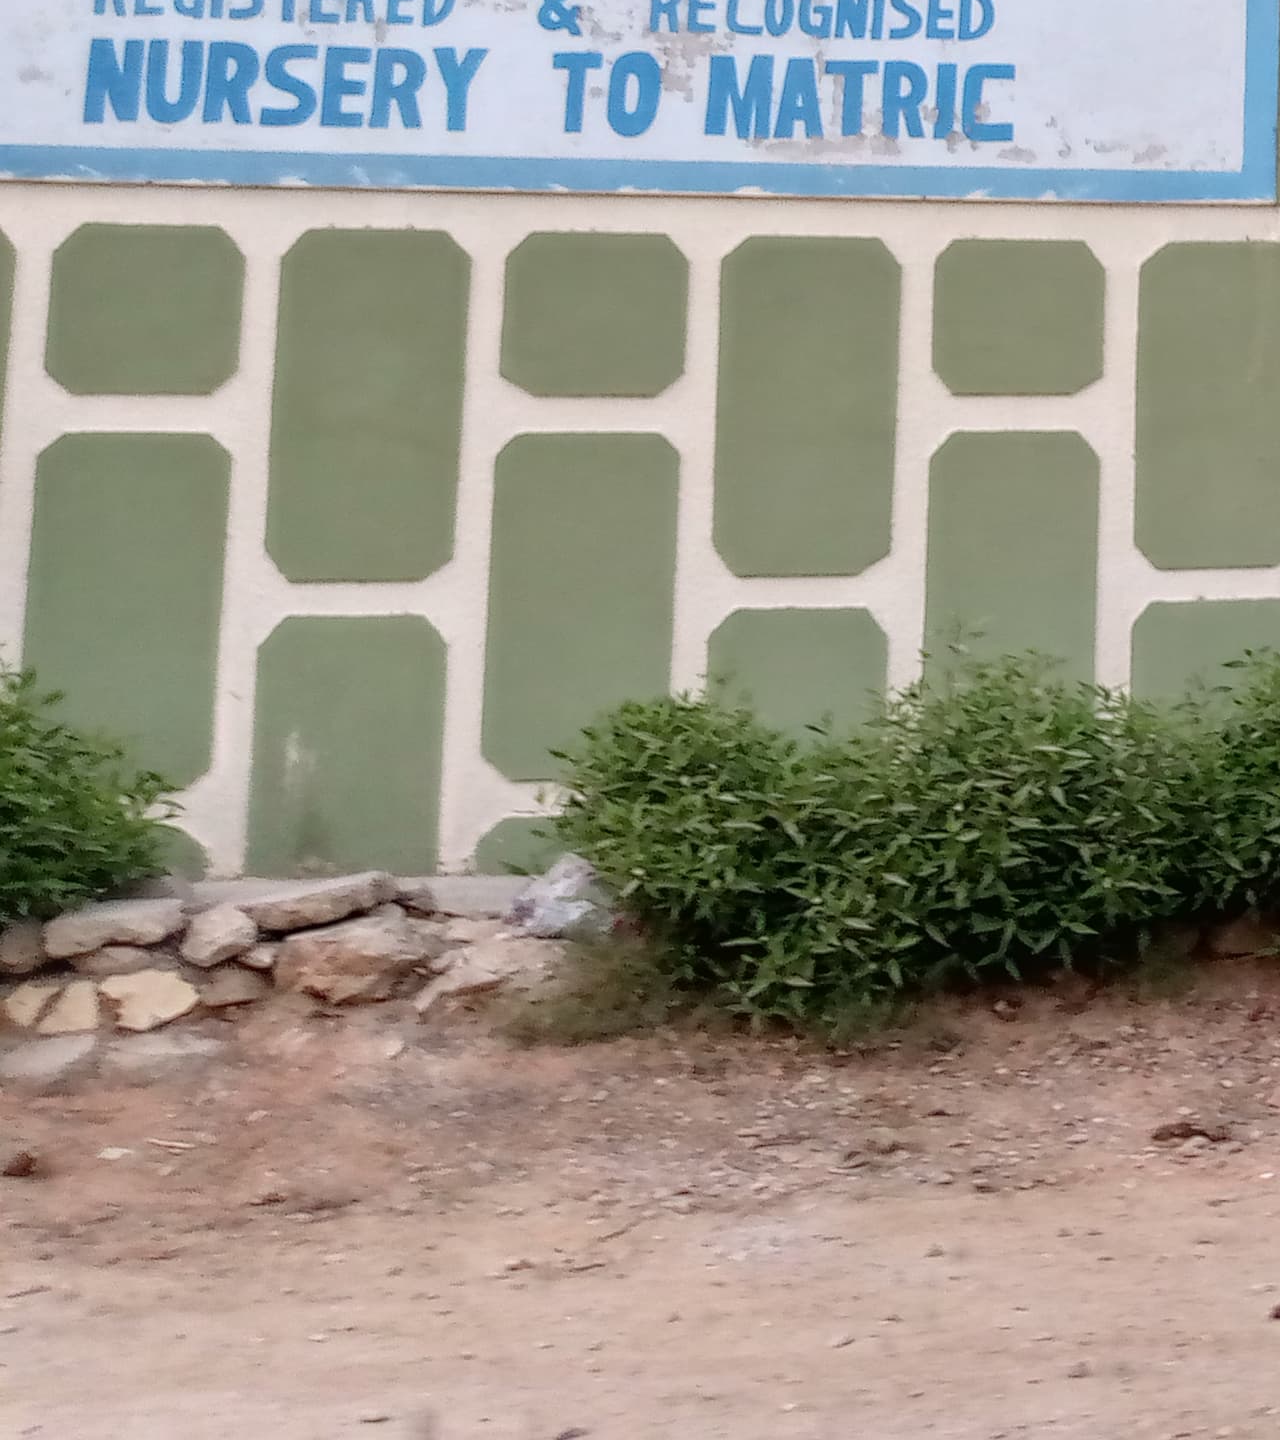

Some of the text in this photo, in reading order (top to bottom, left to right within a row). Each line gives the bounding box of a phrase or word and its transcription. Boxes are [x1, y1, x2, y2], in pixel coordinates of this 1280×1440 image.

[83, 38, 1015, 142] NURSERY TO MATRIC
